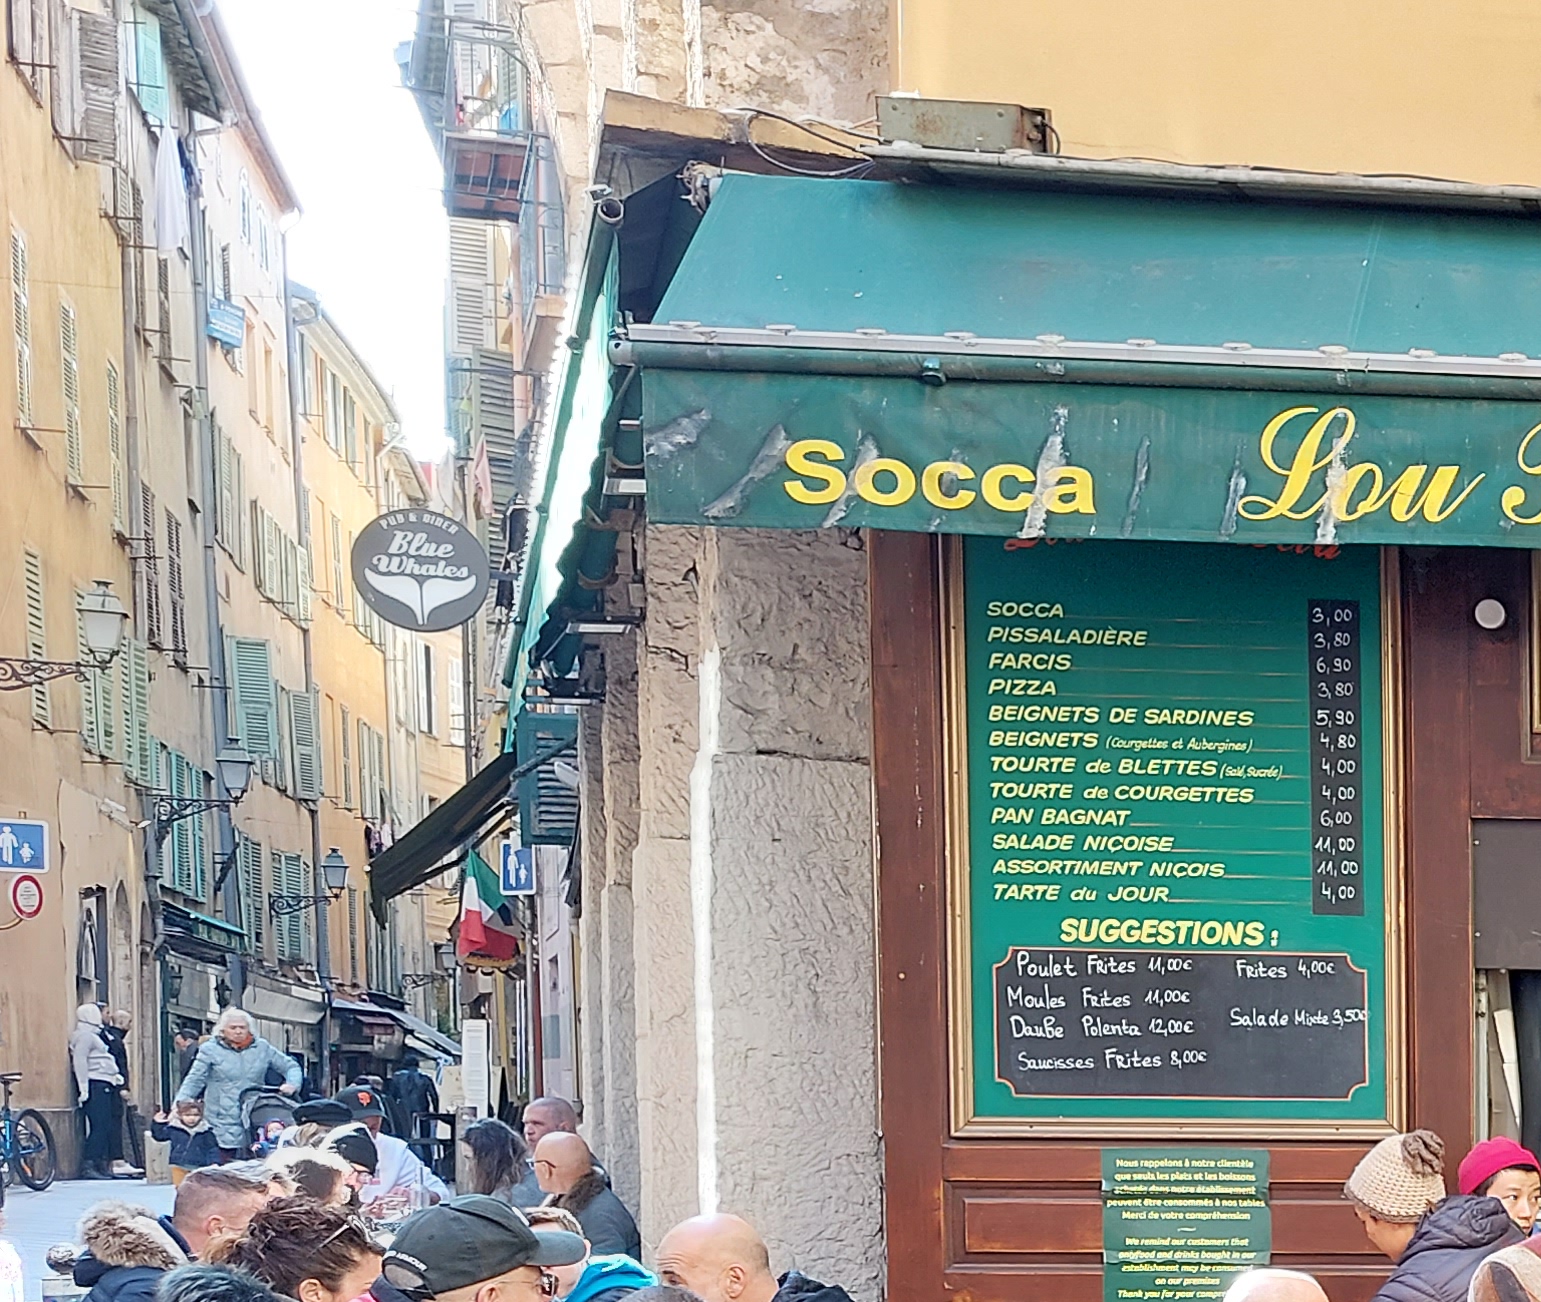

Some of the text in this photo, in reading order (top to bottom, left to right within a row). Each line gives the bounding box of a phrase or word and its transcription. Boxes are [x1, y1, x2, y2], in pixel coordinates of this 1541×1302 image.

[783, 439, 1097, 515] Socca
[1237, 406, 1485, 526] Lou
[379, 512, 459, 535] PUB & DINER
[387, 531, 455, 558] Blue
[372, 554, 469, 578] Whales
[987, 601, 1064, 618] SOCCA
[1312, 607, 1352, 627] 3,00
[987, 625, 1148, 646] PISSALADIÈRE
[1314, 632, 1351, 650] 3,80
[988, 653, 1072, 670] FARCIS
[1316, 657, 1352, 675] 6,90
[988, 678, 1057, 696] PIZZA
[1317, 682, 1354, 699] 3,80
[988, 705, 1255, 726] BEIGNETS DE SARDINES
[1315, 710, 1355, 728] 5,90
[988, 731, 1254, 754] BEIGNETS (Courgettes et Aubergines)
[1320, 733, 1356, 752] 4,80
[990, 756, 1077, 773] TOURTE
[1085, 758, 1112, 774] de
[1117, 759, 1218, 776] BLETTES
[1321, 758, 1356, 777] 4,00
[989, 782, 1255, 803] TOURTE de COURGETTES
[1322, 785, 1355, 805] 4,00
[991, 807, 1132, 826] PAN BAGNAT
[1320, 810, 1353, 828] 6,00
[992, 834, 1174, 853] SALADE NIÇOISE
[1314, 837, 1355, 855] 11,00
[992, 859, 1226, 879] ASSORTIMENT NIÇOIS
[1317, 860, 1359, 877] 11,00
[993, 883, 1170, 902] TARTE du JOUR
[1321, 882, 1355, 905] 4,00
[1016, 950, 1078, 978] Poulet
[1148, 956, 1193, 975] 11,00€
[1297, 958, 1336, 979] 4,00€
[1006, 983, 1067, 1009] Moules
[1144, 989, 1191, 1007] 11,00€
[1009, 1015, 1065, 1039] Daube
[1081, 1015, 1143, 1037] Polenta
[1229, 1007, 1289, 1028] Salade
[1018, 1051, 1094, 1071] Saucisses
[1170, 1050, 1209, 1070] 8,00€
[1116, 1158, 1139, 1168] Nous
[1140, 1158, 1183, 1169] rappelons
[1191, 1159, 1216, 1168] notre
